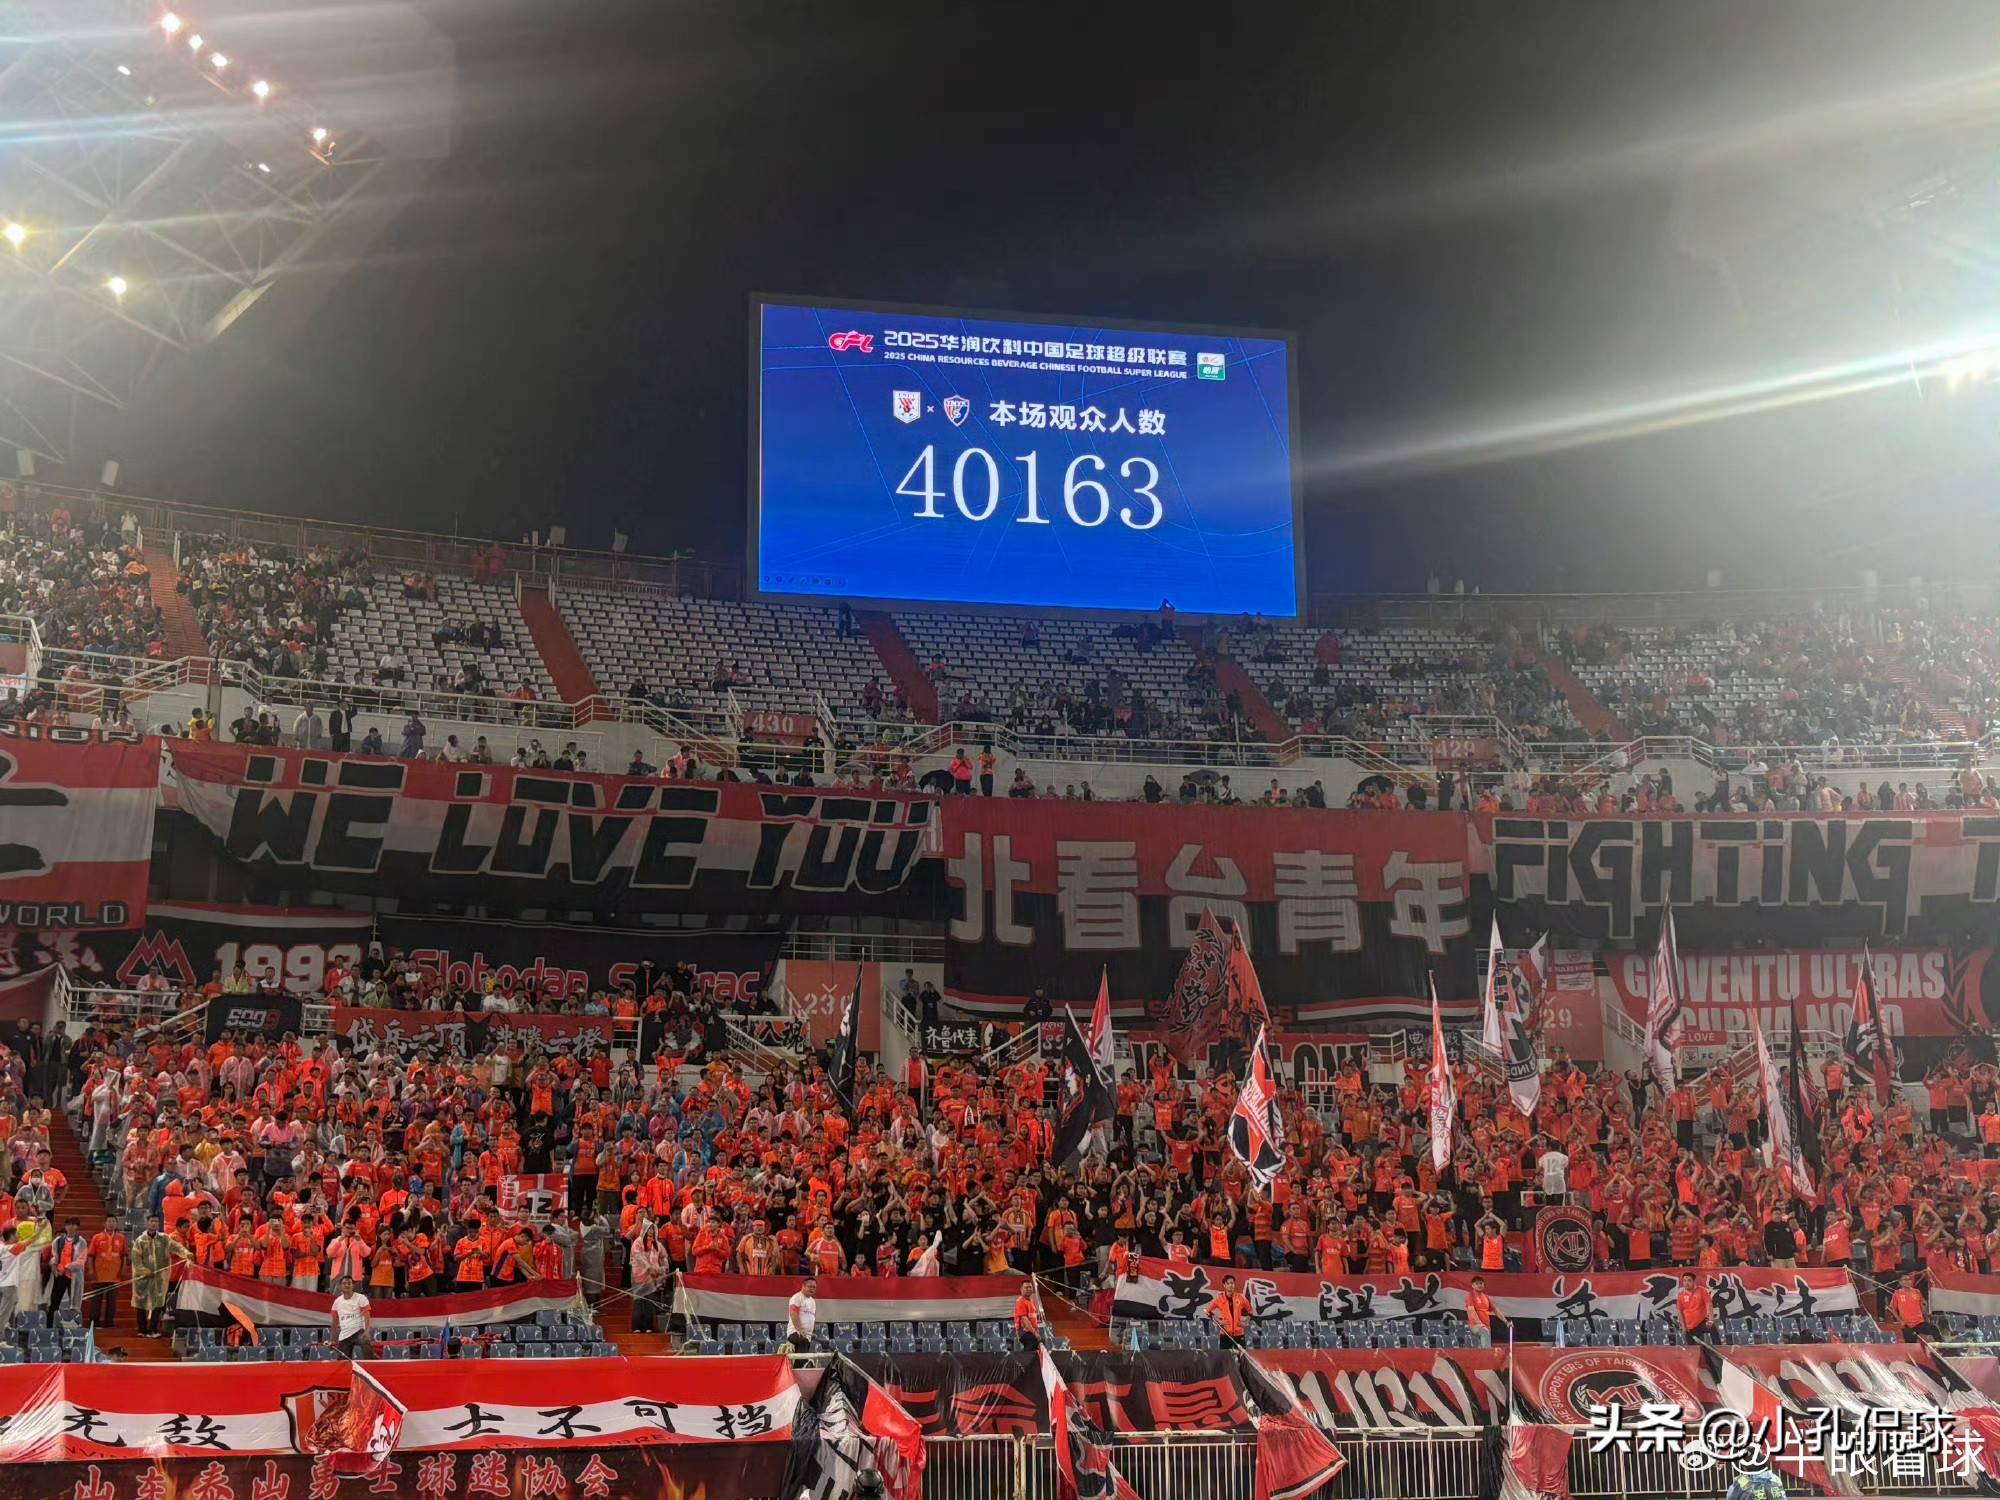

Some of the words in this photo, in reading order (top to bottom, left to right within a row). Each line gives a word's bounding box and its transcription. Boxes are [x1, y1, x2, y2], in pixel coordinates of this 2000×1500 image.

[884, 330, 1188, 366] 2025华润饮料中国足球超级联赛
[884, 351, 906, 360] 2025
[907, 353, 936, 363] CHINA
[937, 355, 990, 366] RESOURCES
[991, 359, 1038, 370] BEVERAGE
[1039, 362, 1076, 372] CHINESE
[1077, 364, 1123, 375] FOOTBALL
[1123, 368, 1153, 378] SUPER
[1153, 370, 1188, 380] LEAGUE
[989, 400, 1167, 436] 本场观众人数
[894, 443, 1165, 531] 40163
[428, 771, 722, 889] LOVE
[947, 829, 1471, 955] 北看台青年
[1493, 817, 1914, 940] FIGHTING
[1687, 1032, 1716, 1042] LOVE
